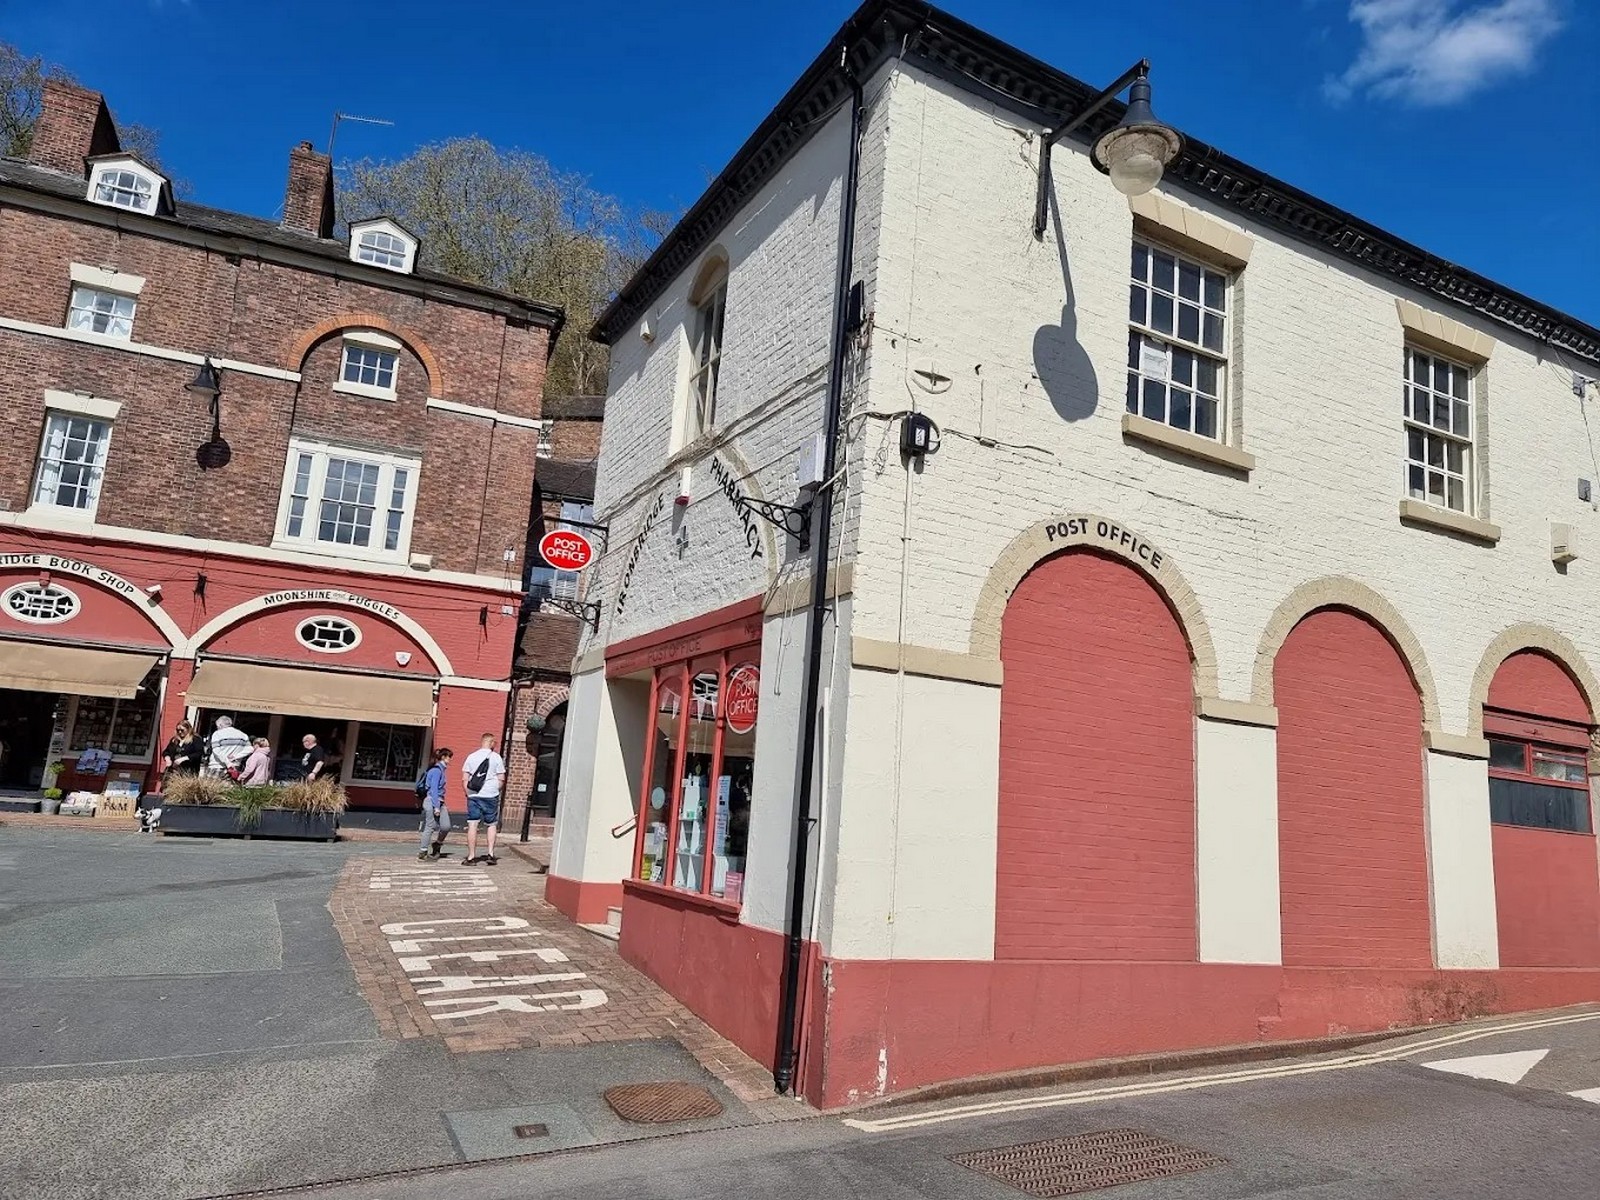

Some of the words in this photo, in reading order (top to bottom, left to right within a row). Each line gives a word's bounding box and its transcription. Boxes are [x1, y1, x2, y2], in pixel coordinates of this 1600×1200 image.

[710, 456, 763, 560] PHARMACY
[545, 546, 586, 563] OFFICE
[553, 537, 583, 551] POST
[1045, 518, 1089, 542] POST
[1097, 521, 1163, 570] OFFICE
[49, 557, 91, 575] BOOK
[98, 572, 135, 594] SHOP
[263, 591, 331, 605] MOONSHINE
[348, 594, 400, 620] FUGGLES
[735, 680, 758, 697] POST
[729, 698, 758, 715] OFFICE
[380, 916, 609, 1020] CLEAR
